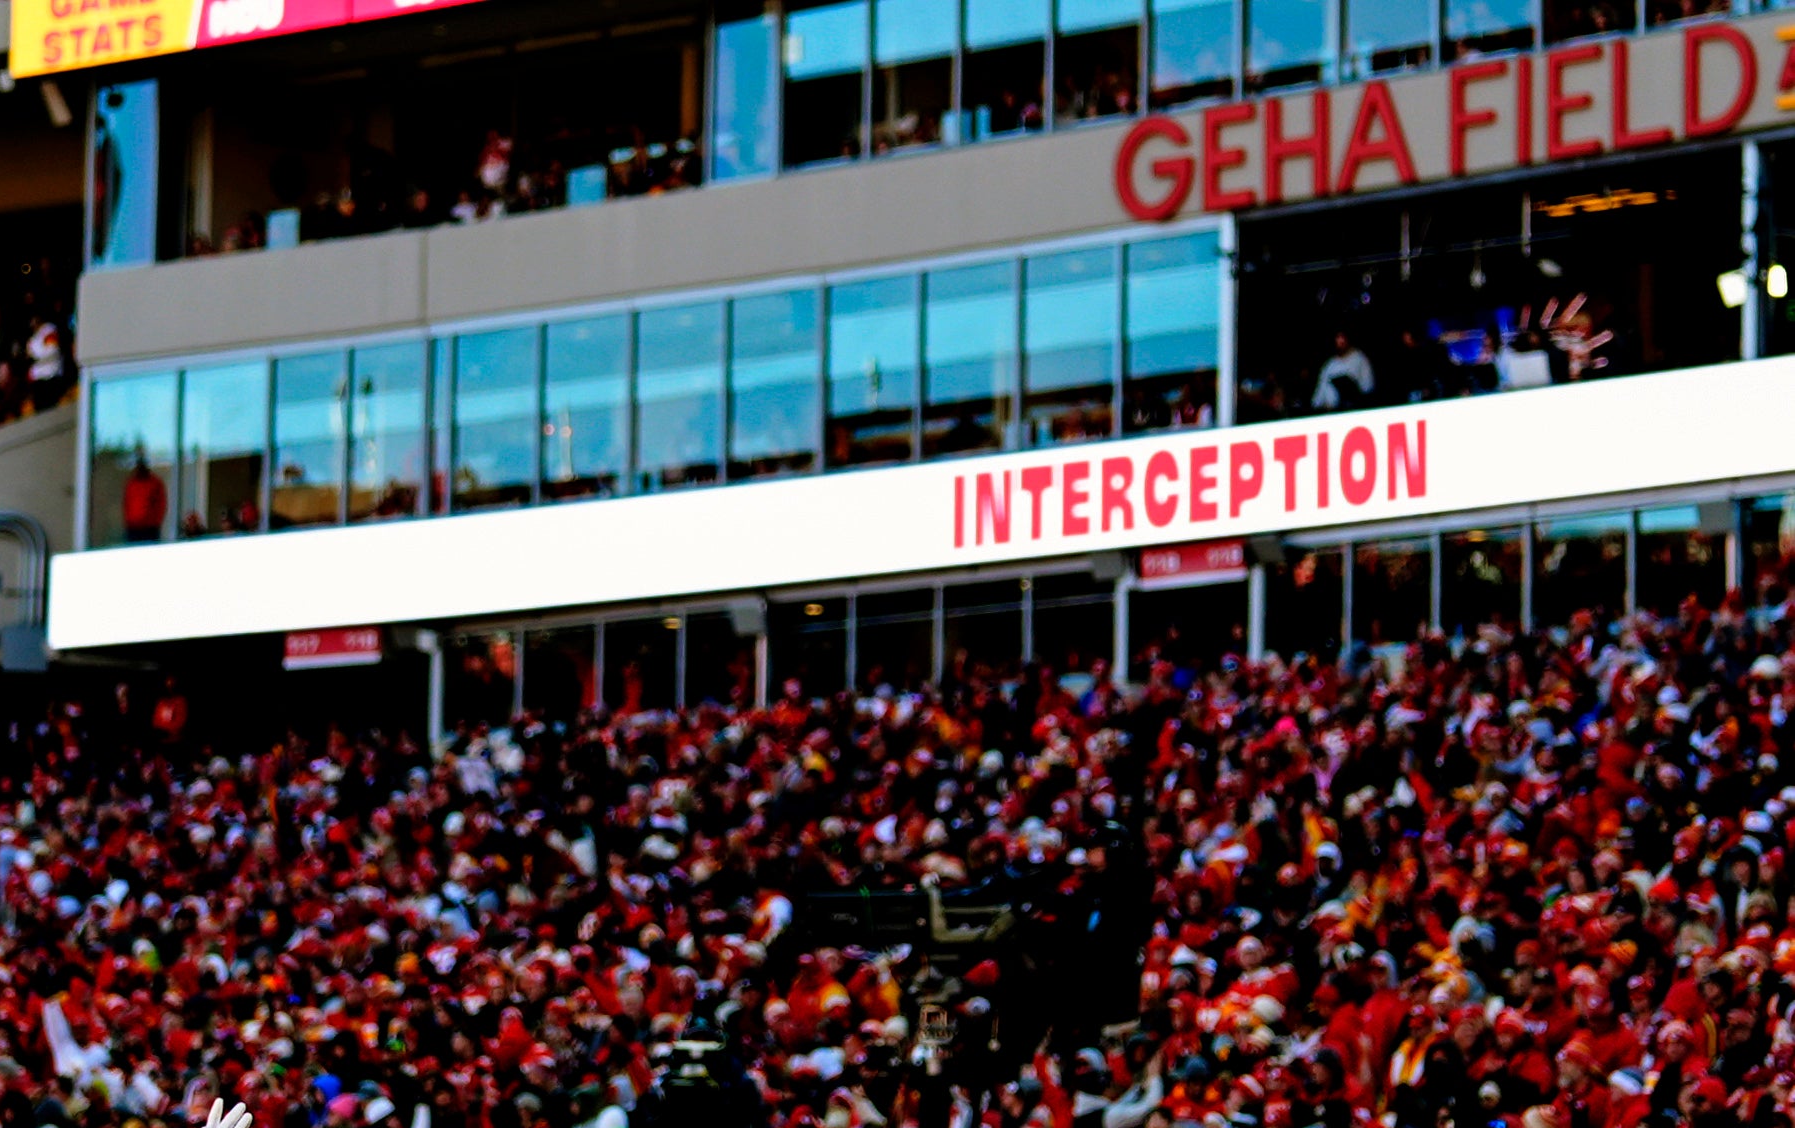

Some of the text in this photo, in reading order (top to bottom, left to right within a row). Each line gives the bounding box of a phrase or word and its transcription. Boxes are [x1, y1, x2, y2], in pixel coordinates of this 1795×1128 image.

[43, 14, 163, 63] STATS
[1115, 23, 1757, 221] GEHA FIELD
[954, 420, 1427, 548] INTERCEPTION
